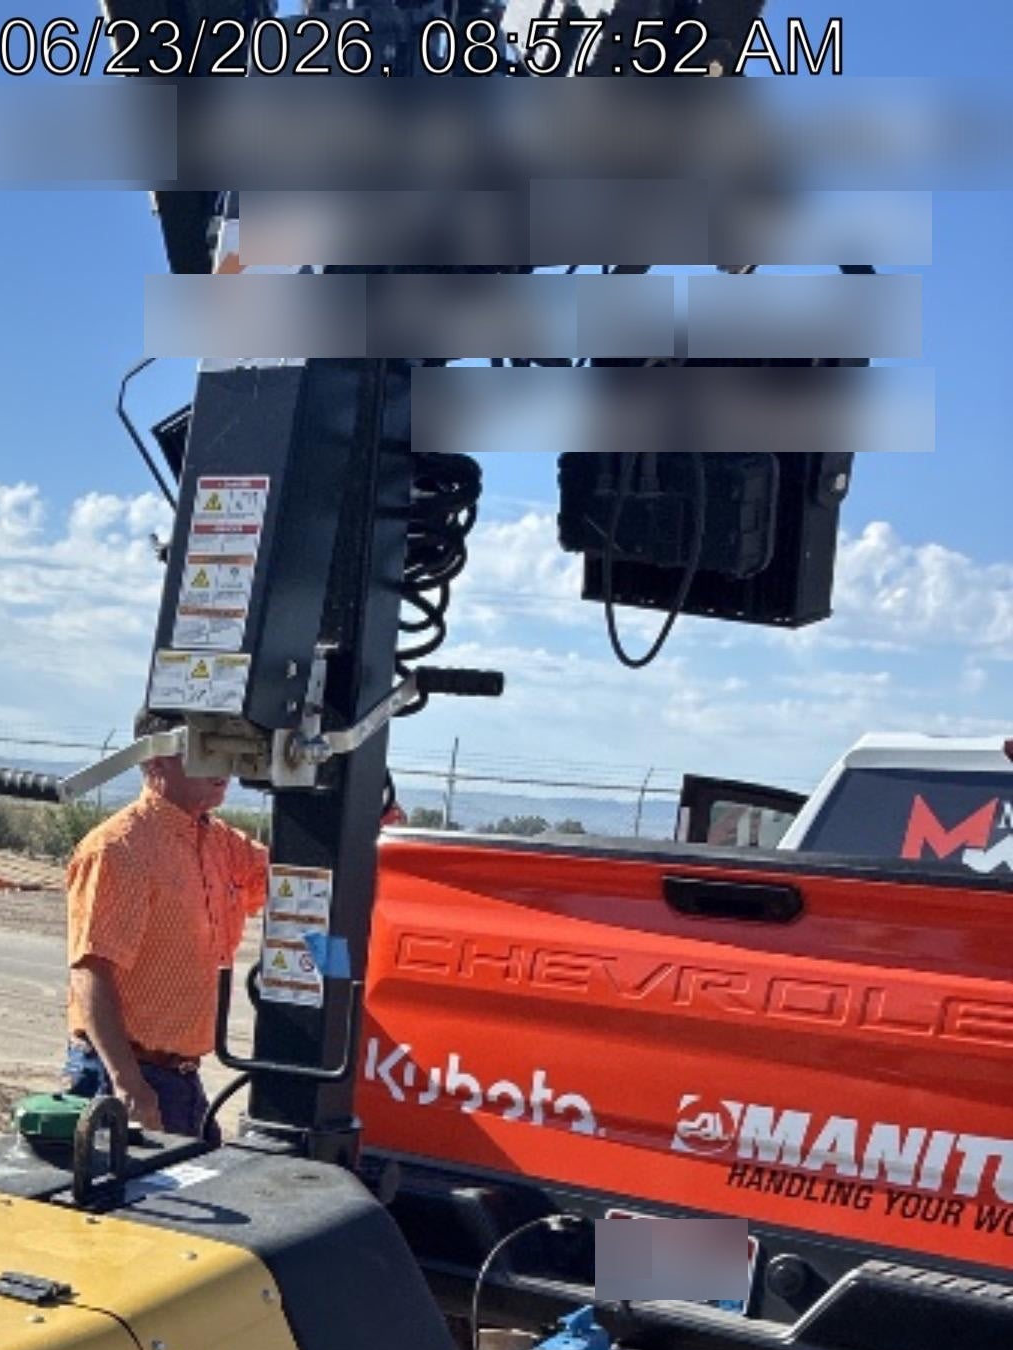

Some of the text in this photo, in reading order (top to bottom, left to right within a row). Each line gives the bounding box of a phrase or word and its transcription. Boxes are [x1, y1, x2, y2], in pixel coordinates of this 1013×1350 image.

[365, 1037, 600, 1137] Kubota
[726, 1163, 874, 1211] HANDLING
[886, 1189, 966, 1228] YOUR
